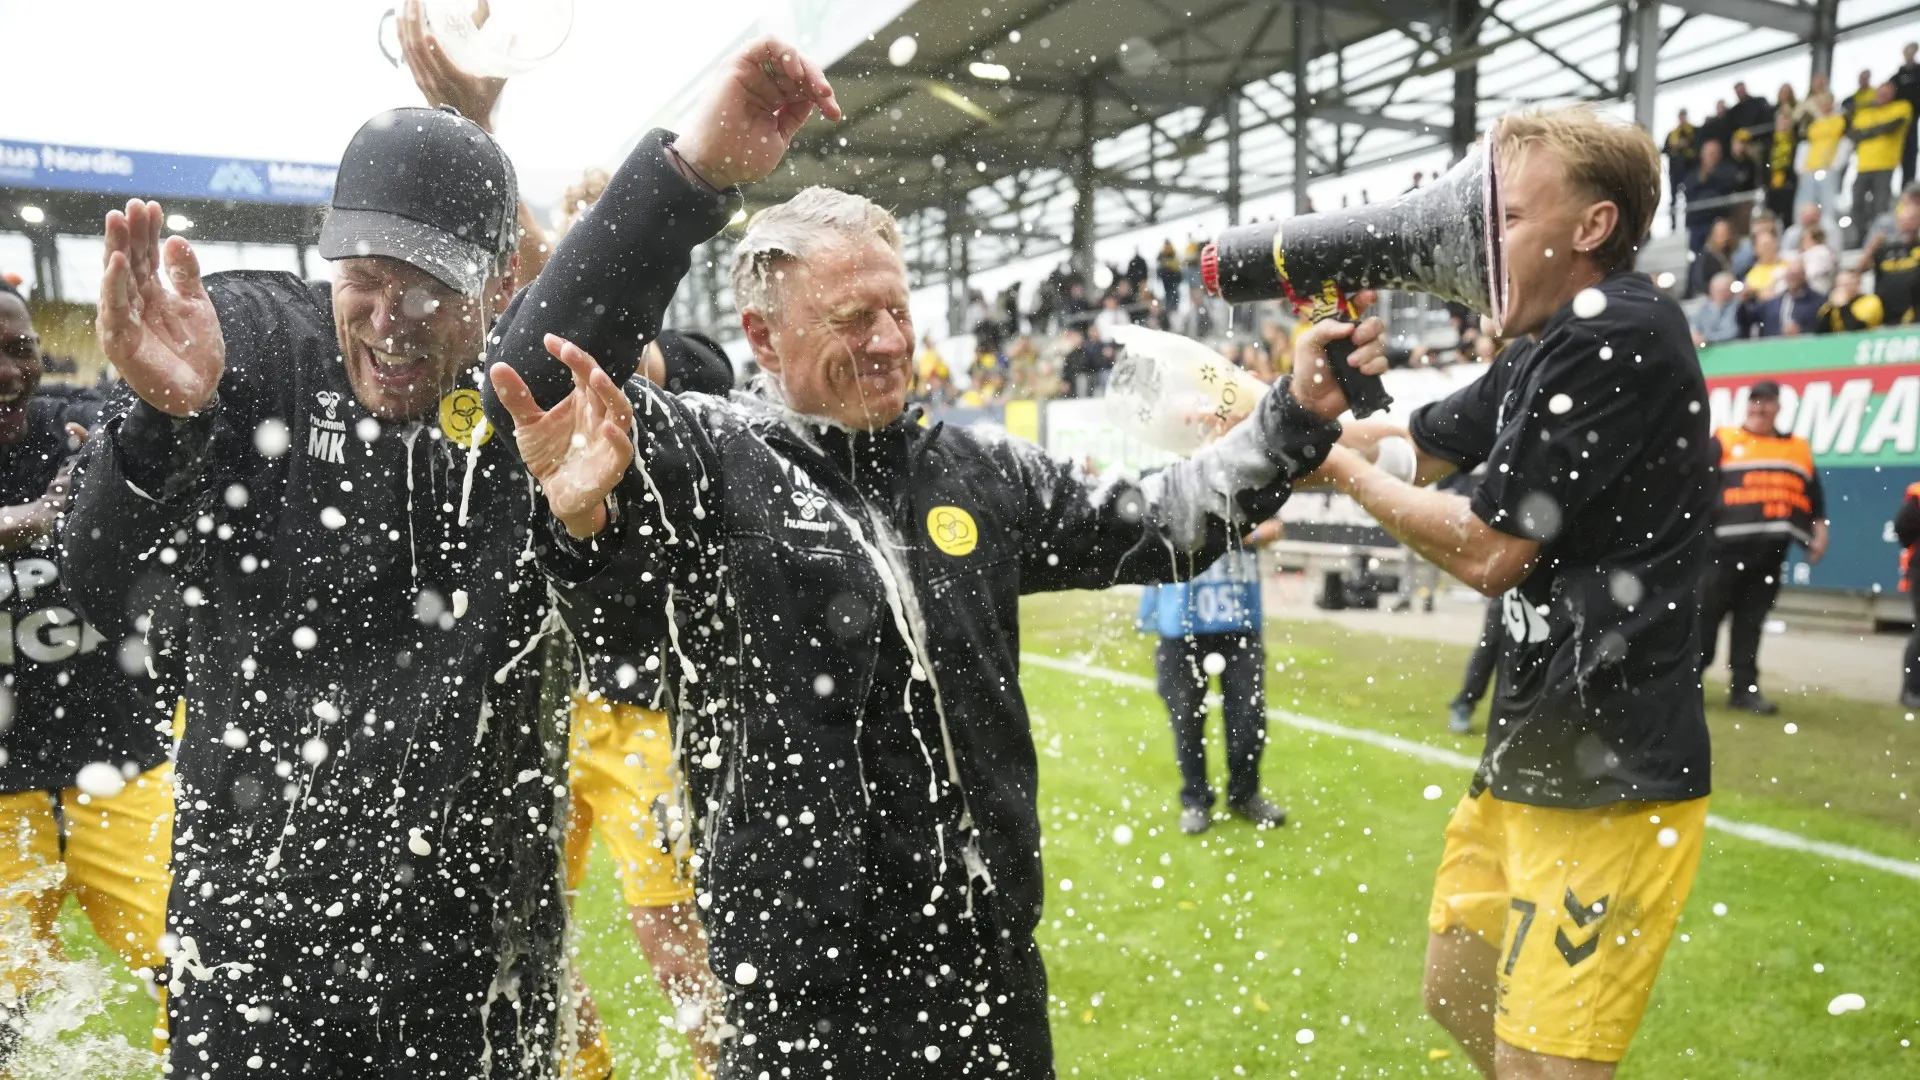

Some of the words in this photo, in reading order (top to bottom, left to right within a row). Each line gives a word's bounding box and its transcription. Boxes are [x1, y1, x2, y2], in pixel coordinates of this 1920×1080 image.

[41, 145, 133, 176] Nordic
[308, 427, 346, 464] MK
[783, 516, 831, 533] hummel
[1504, 896, 1537, 977] 7
